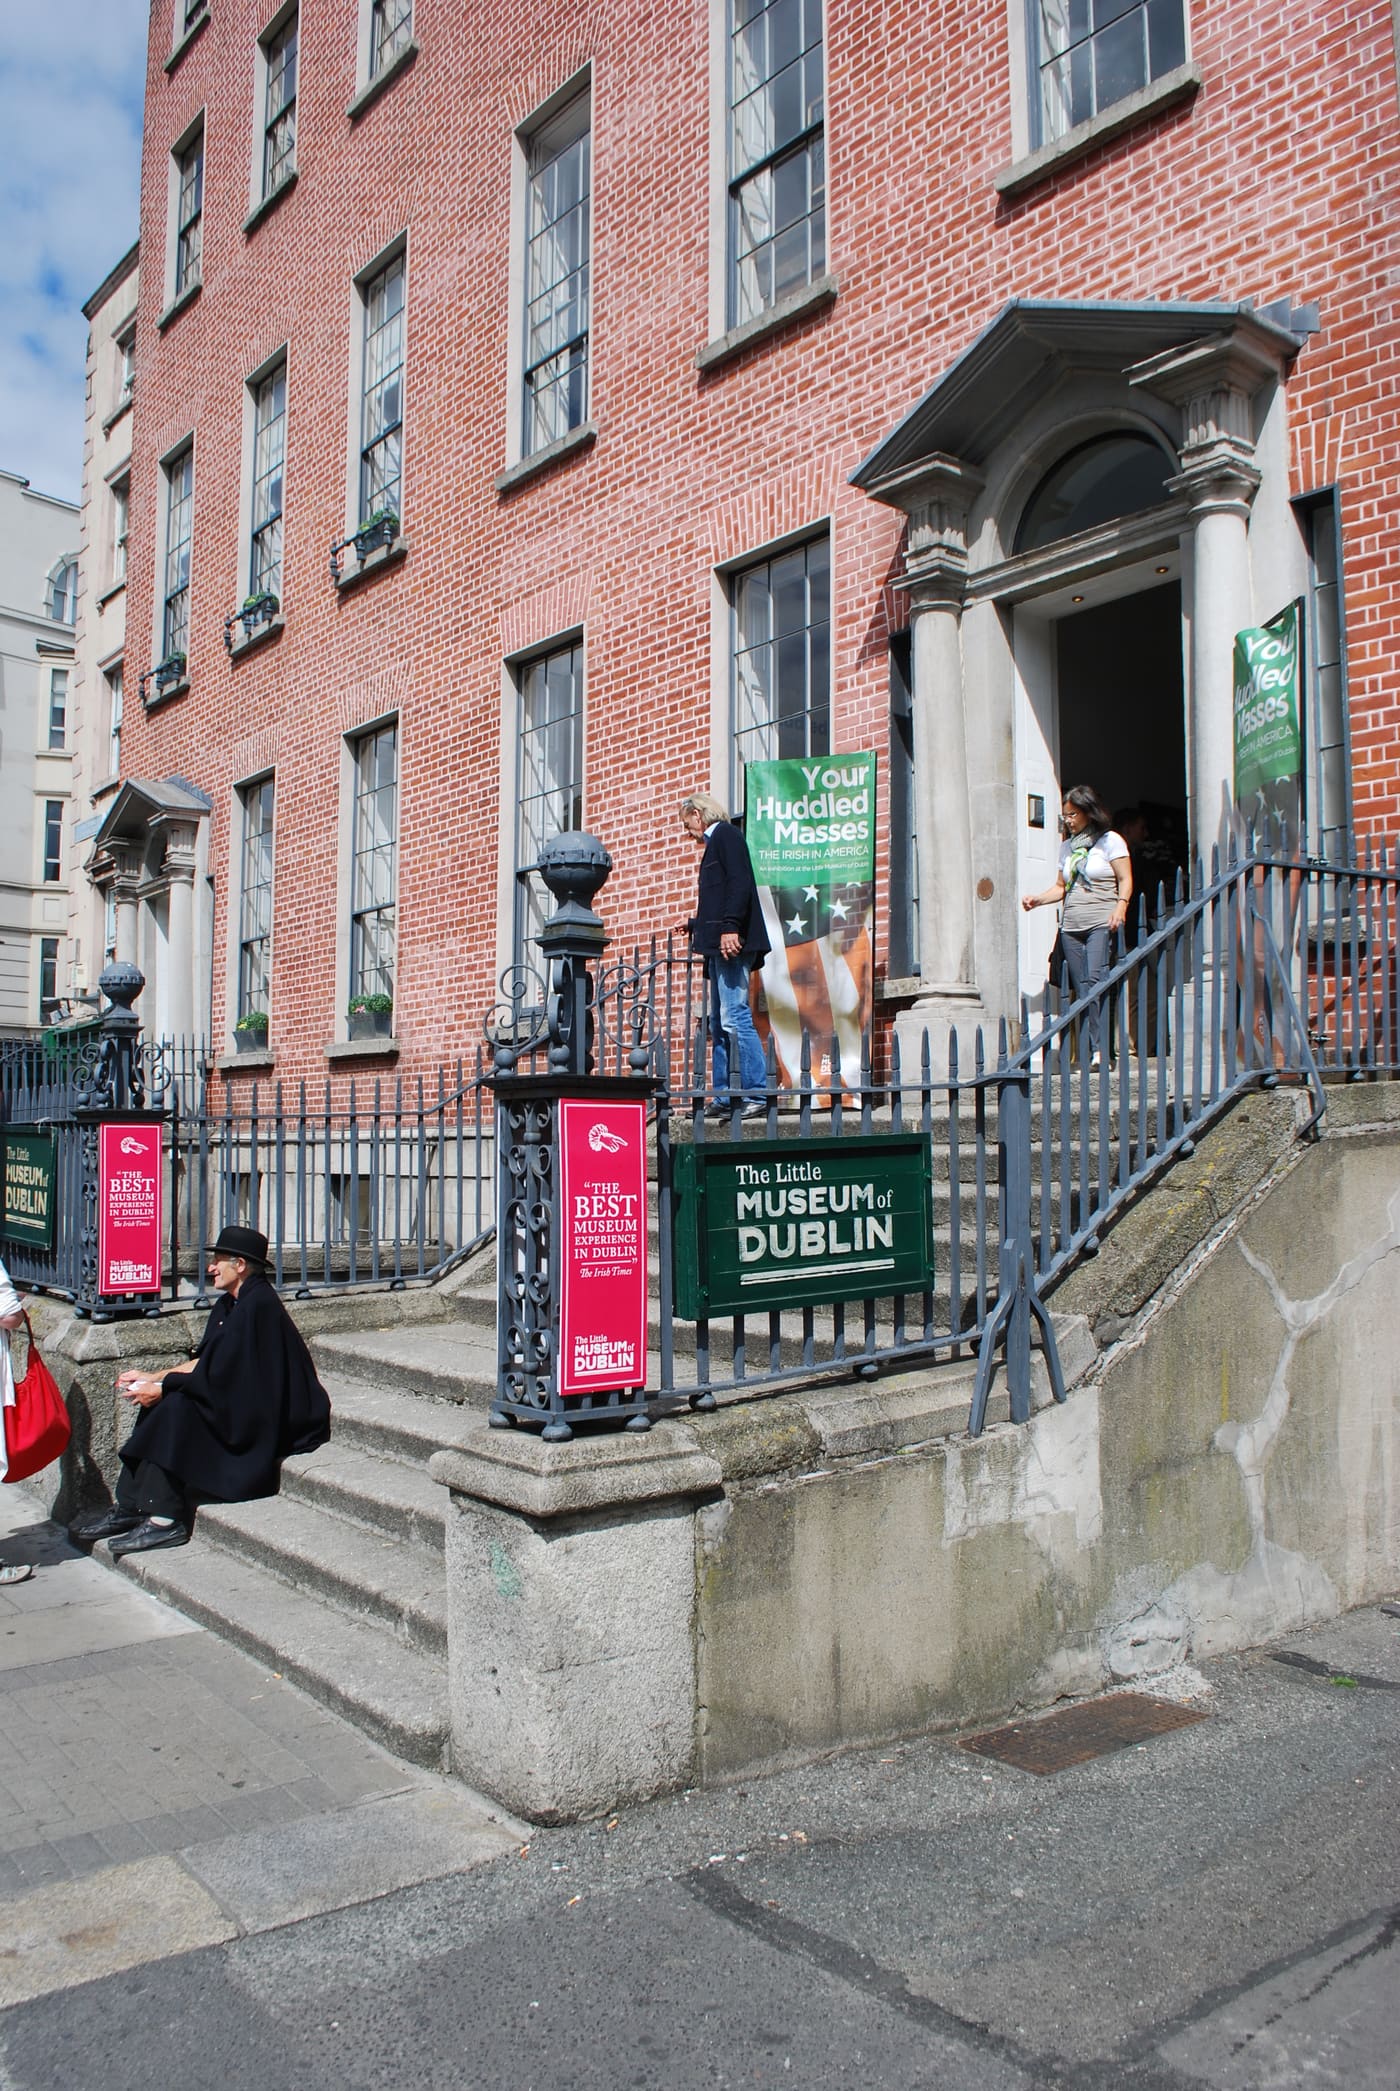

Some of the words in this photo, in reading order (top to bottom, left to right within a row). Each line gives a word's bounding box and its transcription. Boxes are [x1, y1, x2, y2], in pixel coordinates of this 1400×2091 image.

[1246, 622, 1295, 663] You
[801, 765, 869, 791] Your
[756, 789, 869, 821] Huddled
[774, 820, 869, 845] Masses
[759, 849, 779, 859] THE
[782, 849, 810, 859] IRISH
[812, 849, 822, 859] IN
[823, 844, 869, 858] AMERICA
[6, 1163, 43, 1187] MUSEUM
[735, 1164, 770, 1185] The
[775, 1161, 822, 1183] Little
[110, 1178, 155, 1192] BEST
[5, 1185, 48, 1216] DUBLIN
[109, 1193, 154, 1201] MUSEUM
[574, 1194, 638, 1218] BEST
[737, 1183, 875, 1220] MUSEUM
[877, 1189, 894, 1209] of
[574, 1219, 637, 1233] MUSEUM
[574, 1234, 637, 1245] EXPERIENCE
[738, 1214, 894, 1263] DUBLIN
[574, 1248, 588, 1259] IN
[592, 1245, 637, 1258] DUBLIN
[109, 1271, 152, 1281] DUBLIN
[110, 1264, 147, 1273] MUSEUM
[580, 1268, 592, 1278] The
[594, 1266, 611, 1277] Irish
[611, 1265, 632, 1276] Times
[575, 1335, 588, 1344] The
[589, 1333, 608, 1343] Little
[575, 1340, 627, 1356] MUSEUM
[627, 1342, 635, 1352] of
[574, 1351, 634, 1371] DUBLIN
